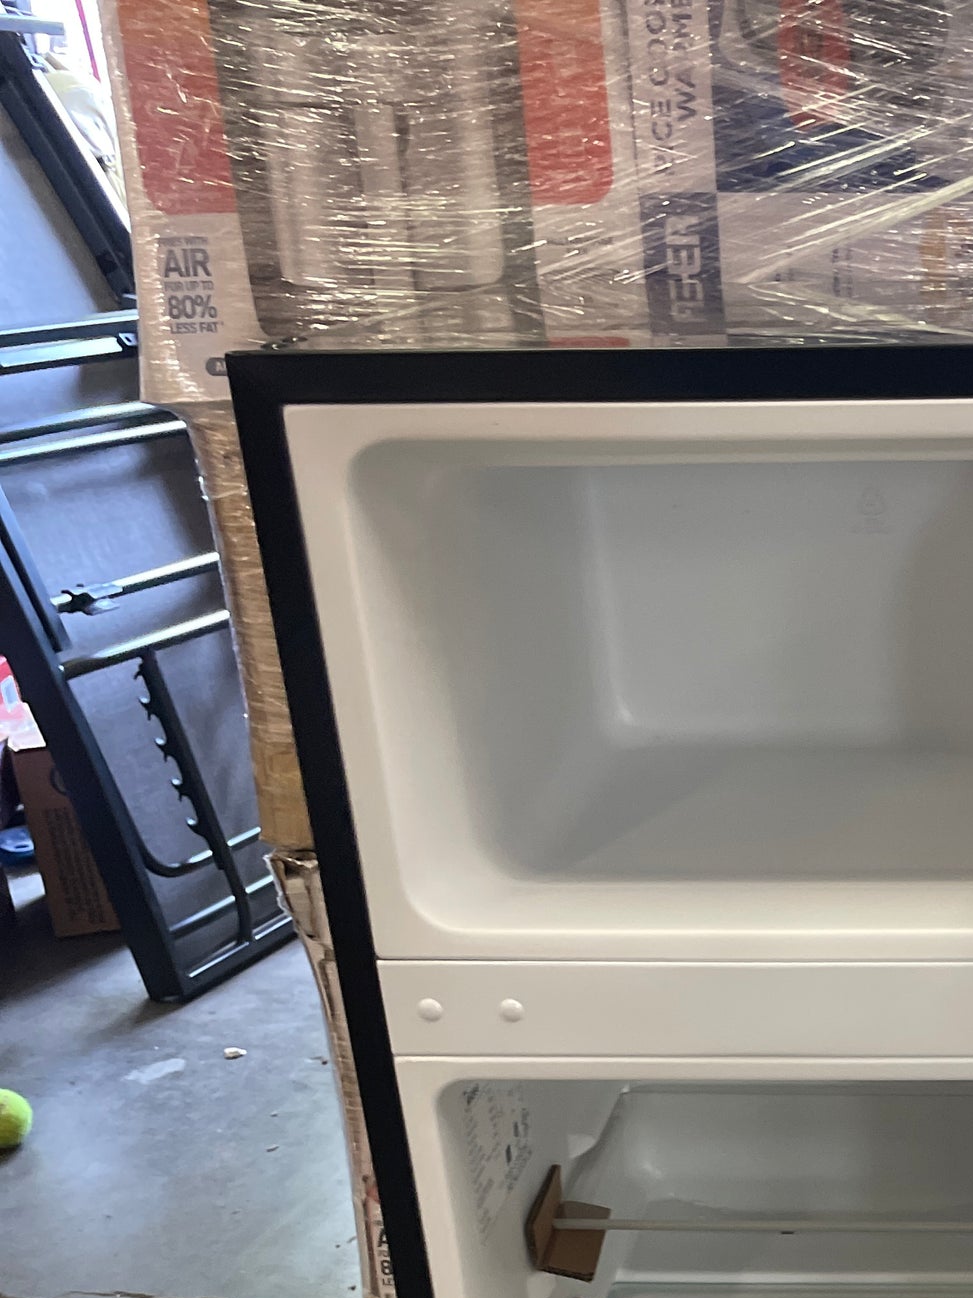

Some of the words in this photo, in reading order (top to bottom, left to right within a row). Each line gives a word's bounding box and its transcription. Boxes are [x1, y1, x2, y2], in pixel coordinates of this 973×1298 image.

[164, 248, 212, 278] AIR
[168, 294, 218, 319] 80%
[170, 322, 197, 334] LESS
